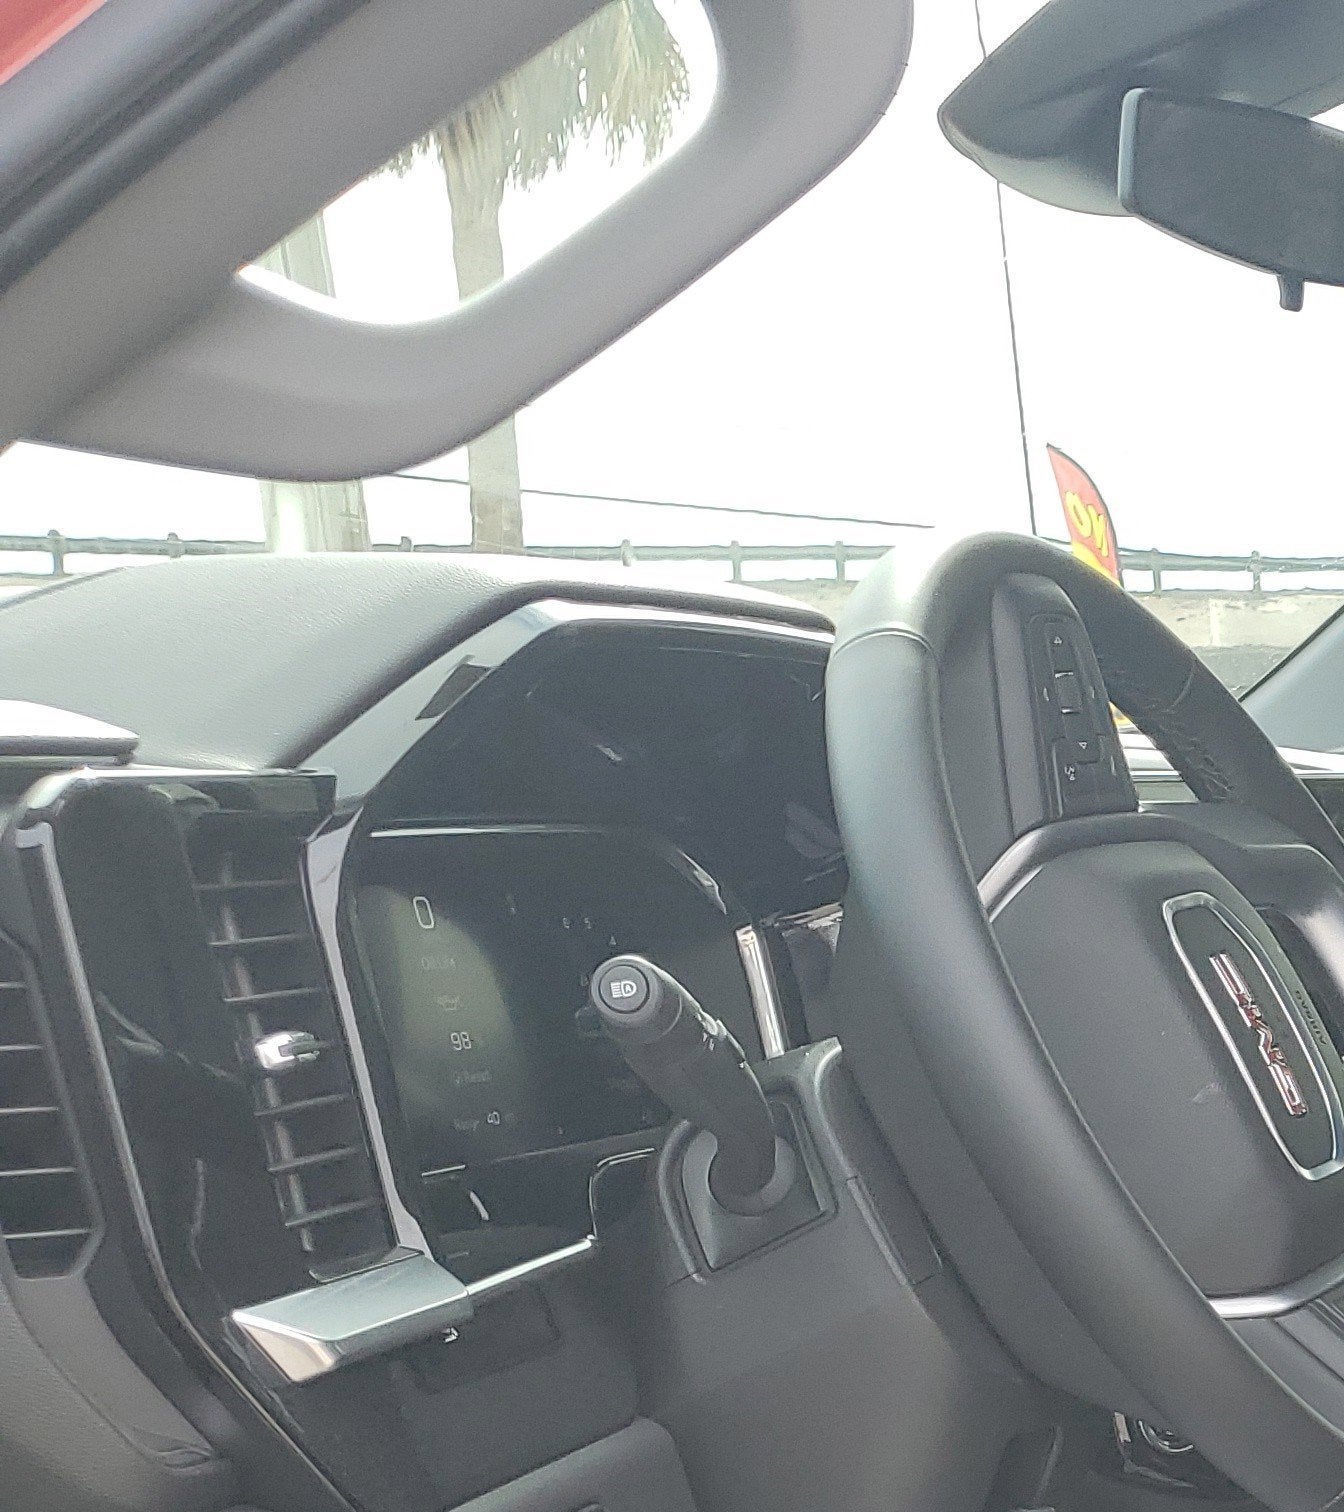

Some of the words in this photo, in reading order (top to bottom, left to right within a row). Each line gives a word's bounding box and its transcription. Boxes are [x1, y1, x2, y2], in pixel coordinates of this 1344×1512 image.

[412, 896, 435, 929] 0
[450, 1032, 472, 1051] 98
[1208, 952, 1308, 1116] GMC
